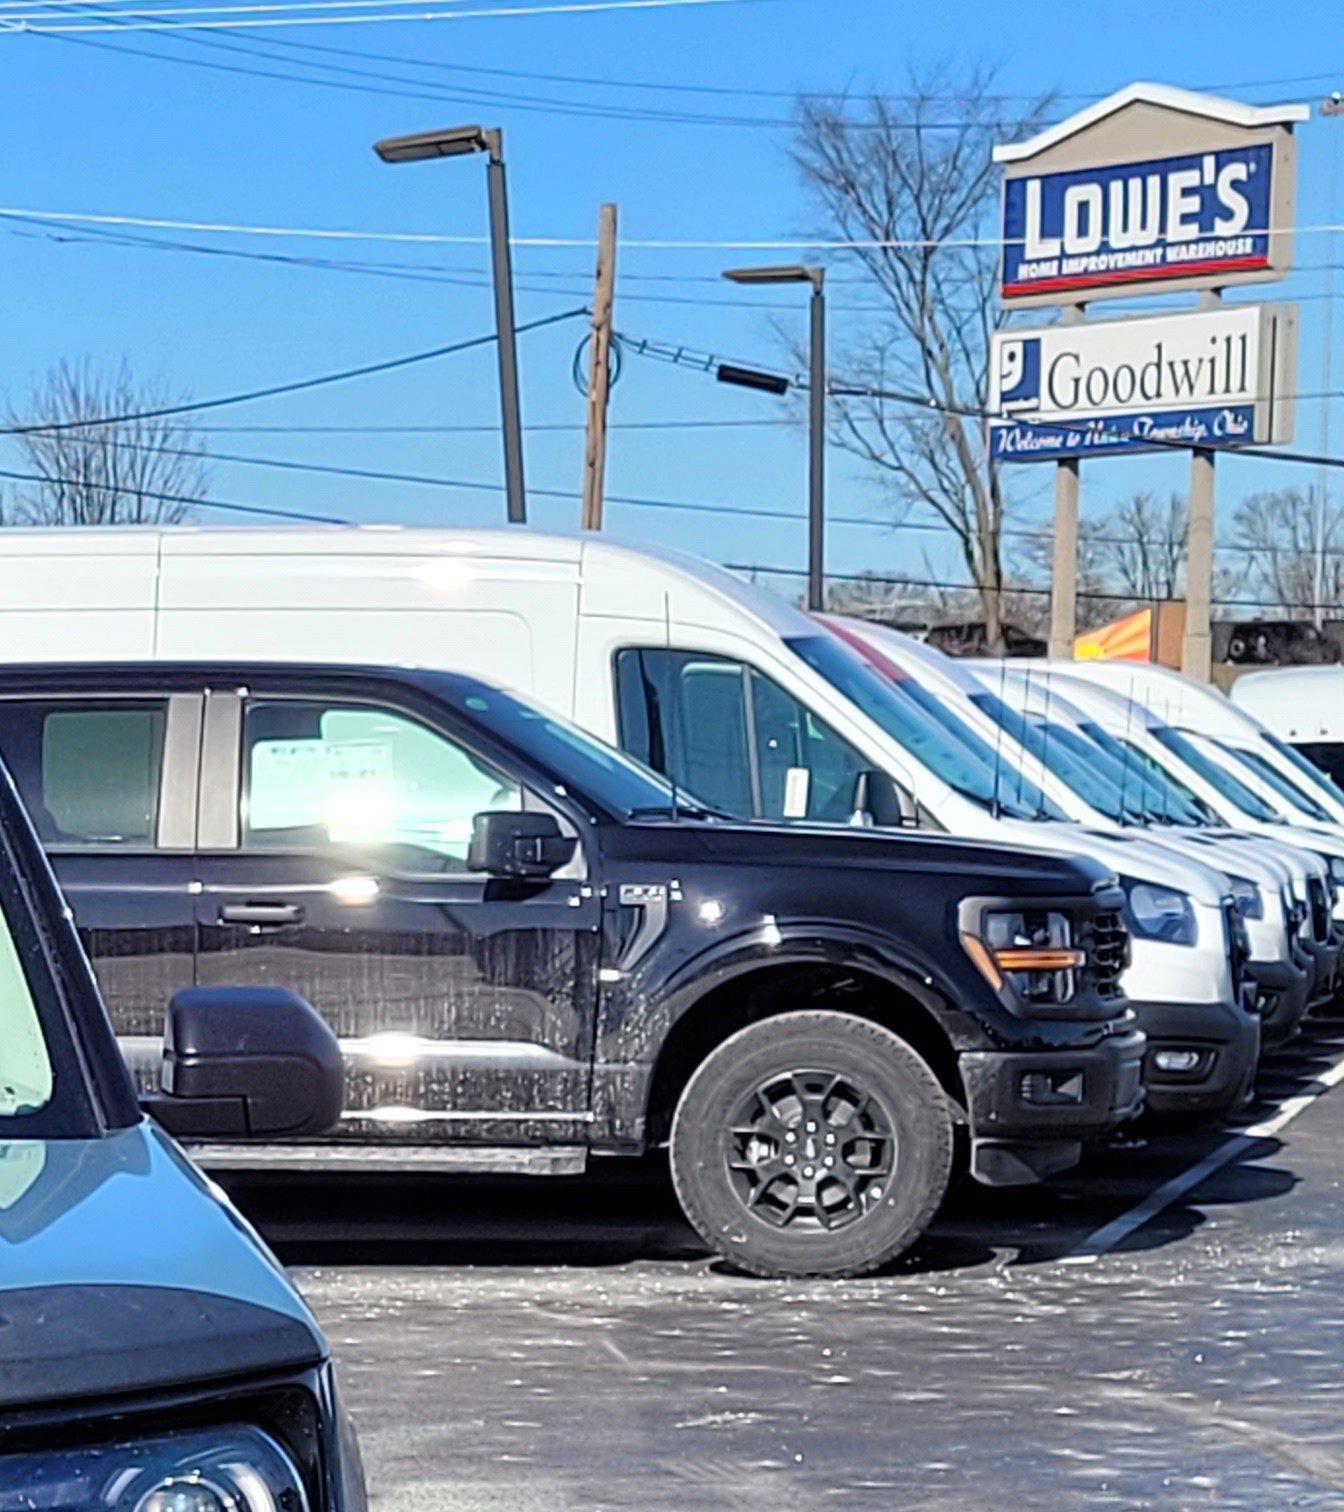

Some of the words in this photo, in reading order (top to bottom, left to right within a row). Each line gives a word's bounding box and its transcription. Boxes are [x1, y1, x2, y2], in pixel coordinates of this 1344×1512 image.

[1024, 154, 1250, 261] LOWE'S
[1017, 259, 1059, 281] HOME
[1062, 248, 1163, 275] IMPROVEMENT
[1165, 237, 1254, 262] WAREHOUSE
[1048, 332, 1249, 410] Goodwill
[998, 428, 1064, 453] Welcome
[1066, 431, 1081, 448] to
[1212, 409, 1250, 437] Ohio
